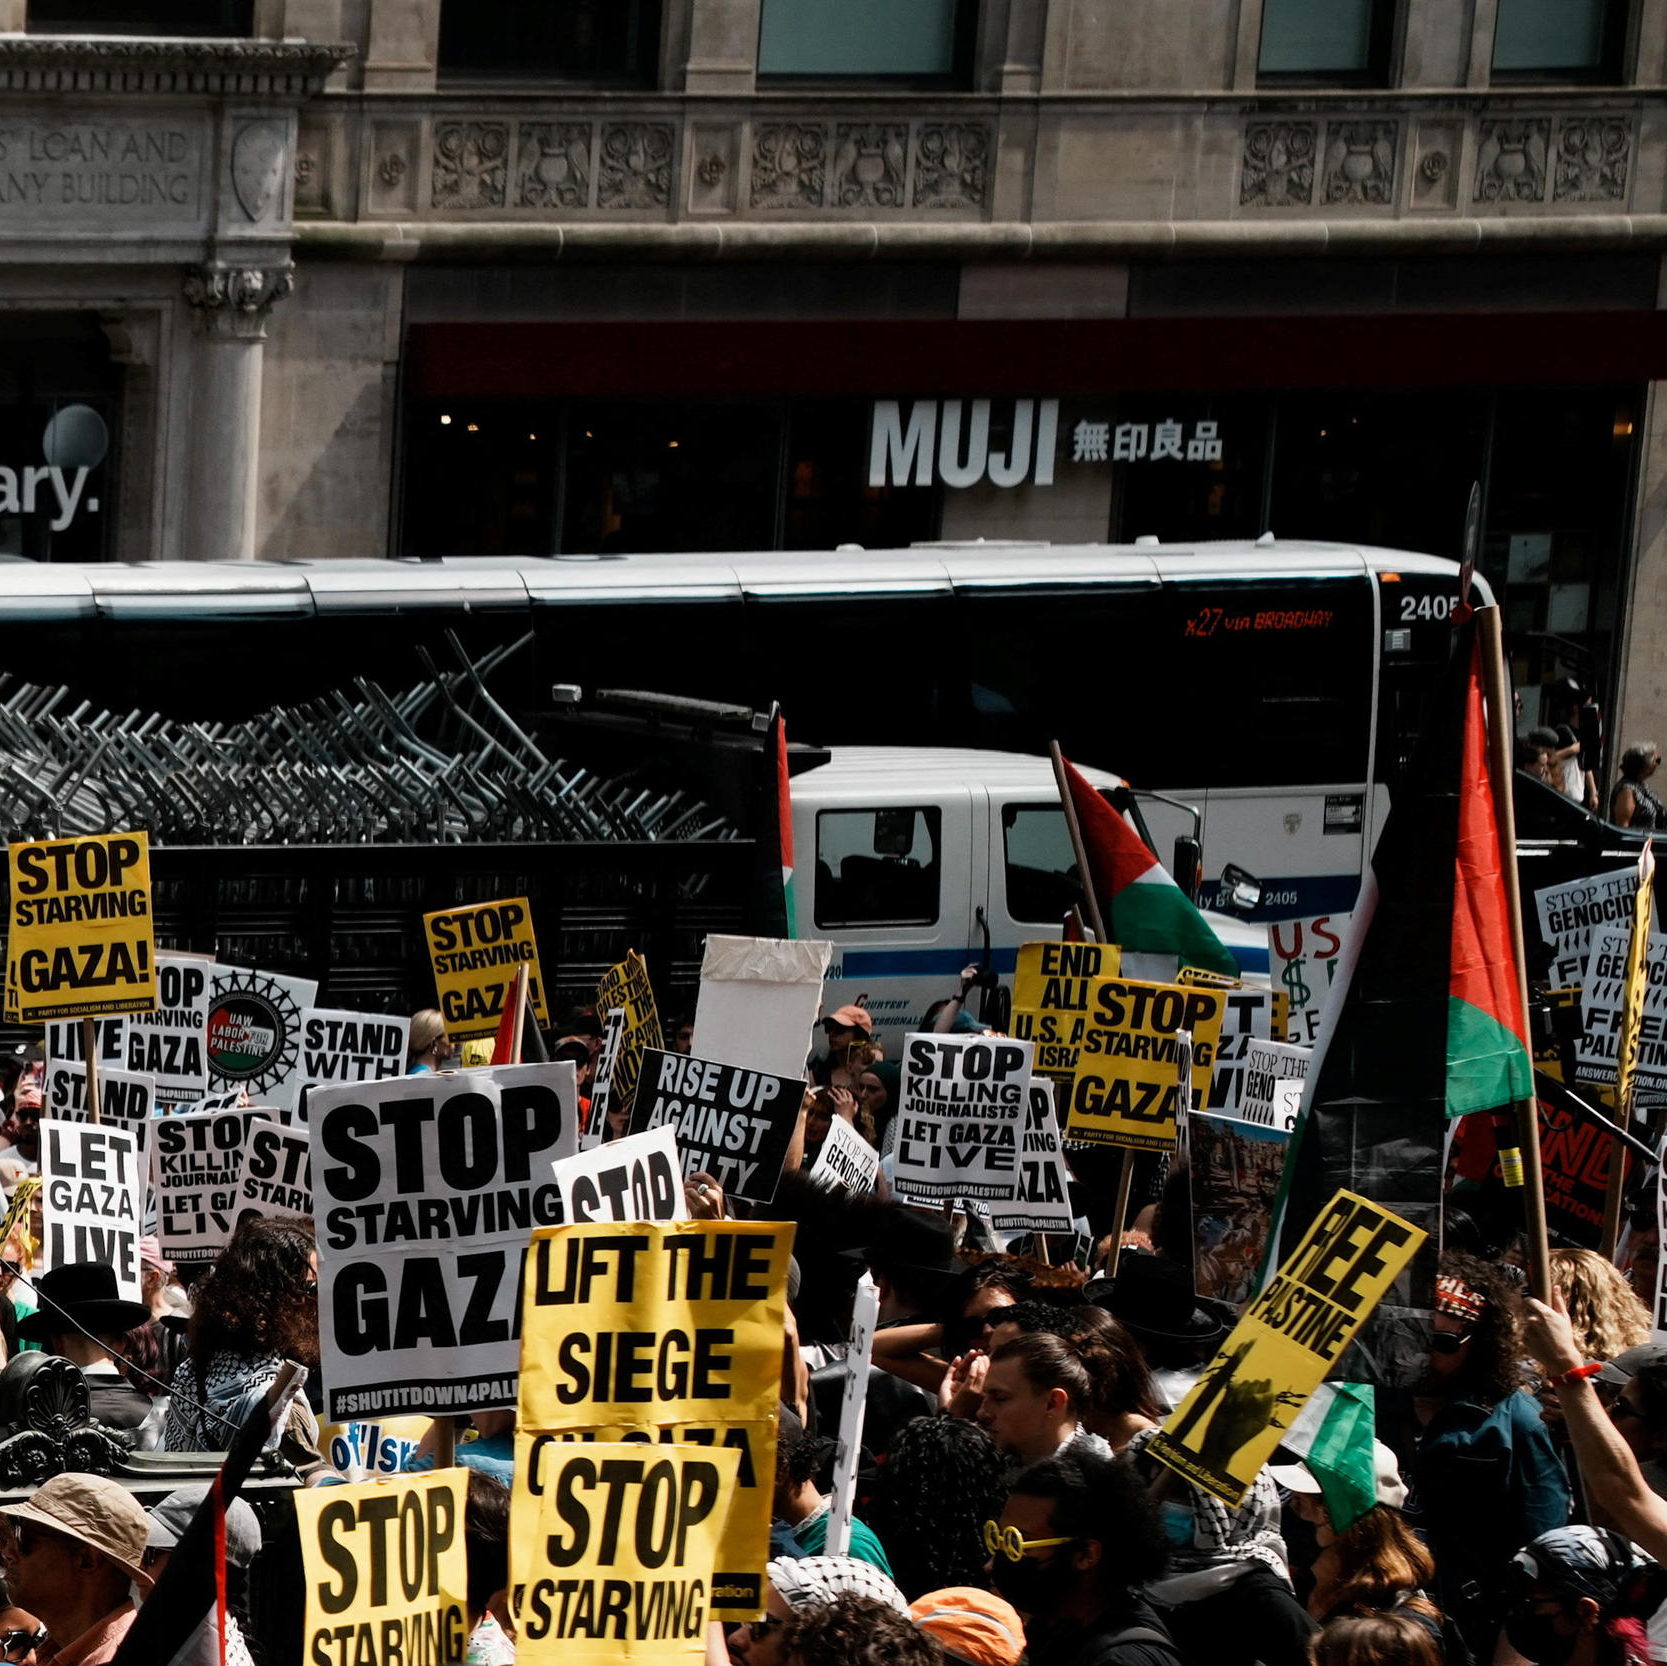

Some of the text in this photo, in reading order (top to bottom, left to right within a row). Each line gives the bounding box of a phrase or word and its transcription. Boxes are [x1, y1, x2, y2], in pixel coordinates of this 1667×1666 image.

[29, 130, 109, 163] LOAN
[120, 130, 188, 163] AND
[62, 172, 189, 204] BUILDING
[869, 400, 1059, 488] MUJI
[1072, 418, 1223, 462] 無印良品
[1253, 608, 1337, 632] BROADWAY
[16, 839, 140, 896] STOP
[15, 890, 147, 928] STARVING
[1264, 889, 1298, 906] 2405
[1546, 886, 1599, 912] STOP
[431, 904, 524, 952] STOP
[20, 940, 149, 993] GAZA!
[434, 939, 535, 974] STARVING
[1041, 945, 1102, 978] END
[228, 1011, 253, 1028] UAW
[1093, 982, 1218, 1039] STOP
[209, 1037, 267, 1058] PALESTINE
[210, 1024, 246, 1039] LABOR
[304, 1019, 403, 1056] STAND
[127, 1034, 203, 1076] GAZA
[906, 1040, 1025, 1081] STOP
[1249, 1049, 1278, 1073] STOP
[657, 1054, 781, 1112] RISE UP
[906, 1076, 1022, 1104] KILLING
[646, 1096, 773, 1155] AGAINST
[904, 1099, 1019, 1120] JOURNALISTS
[321, 1084, 563, 1202] STOP
[901, 1118, 1017, 1147] LET GAZA
[49, 1128, 132, 1184] LET
[898, 1146, 1016, 1172] LIVE
[48, 1179, 135, 1221] GAZA
[326, 1182, 565, 1251] STARVING
[534, 1234, 776, 1307] LIFT THE
[556, 1329, 733, 1404] SIEGE
[547, 1457, 720, 1569] STOP
[317, 1485, 455, 1615] STOP
[525, 1578, 705, 1641] STARVING
